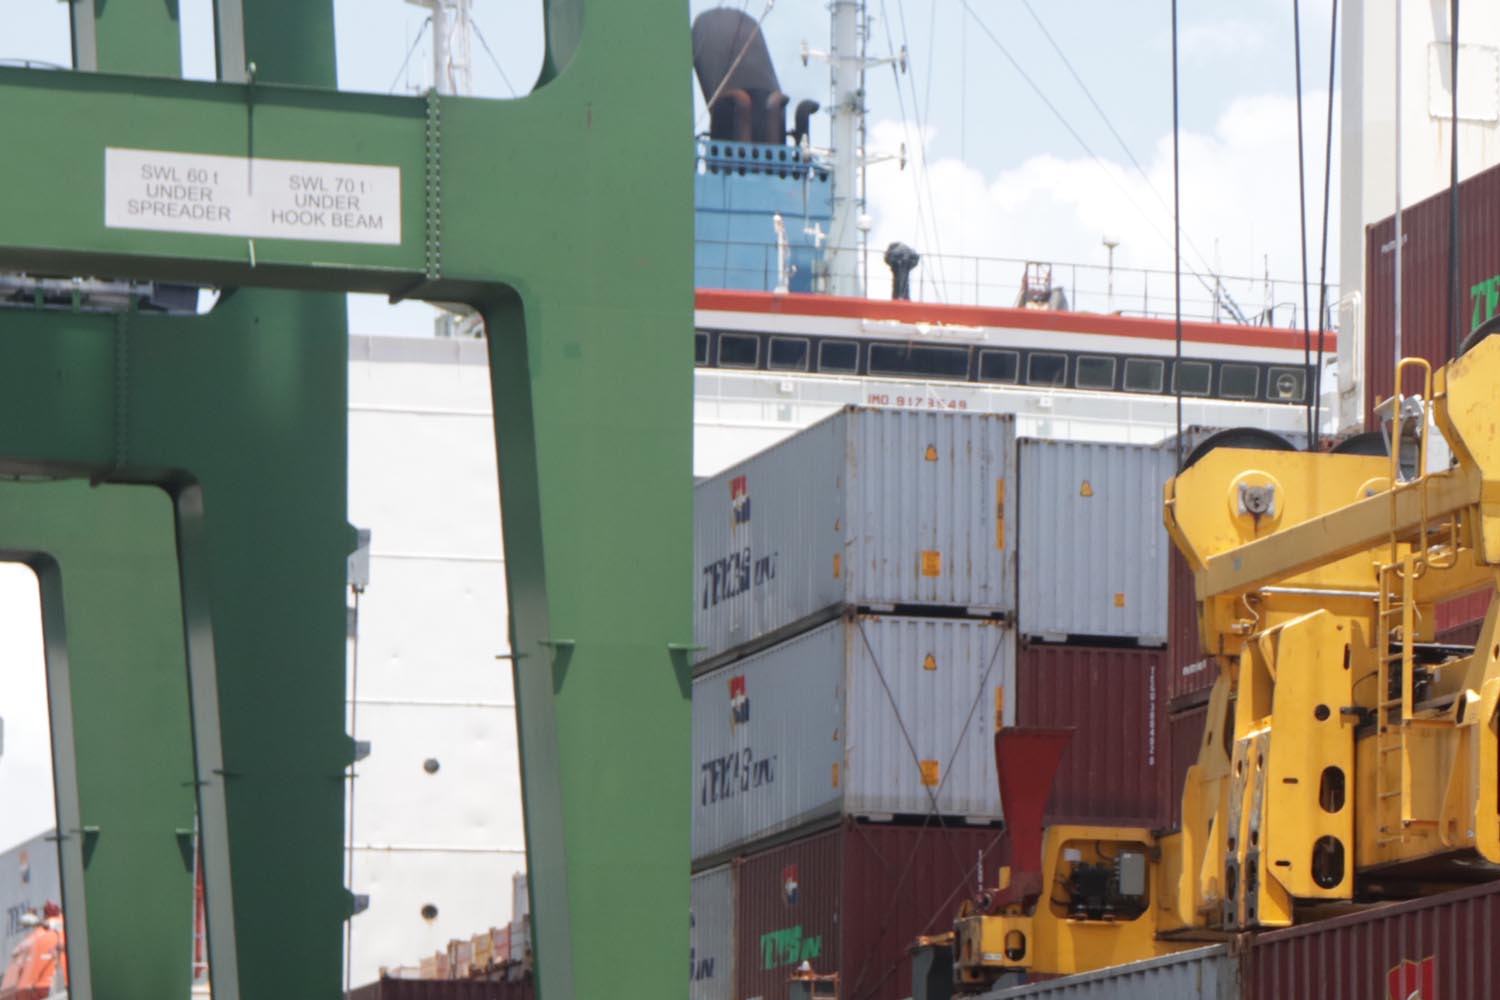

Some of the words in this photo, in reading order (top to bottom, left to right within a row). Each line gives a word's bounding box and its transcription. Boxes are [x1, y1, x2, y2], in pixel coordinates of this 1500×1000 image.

[140, 164, 180, 182] SWL
[187, 168, 208, 184] 60
[213, 170, 219, 185] t
[146, 183, 213, 202] UNDER
[289, 175, 328, 193] SWL
[335, 177, 356, 193] 70
[360, 179, 365, 195] t
[127, 200, 231, 222] SPREADER
[294, 194, 360, 211] UNDER
[271, 209, 326, 227] HOOK
[331, 213, 383, 230] BEAM
